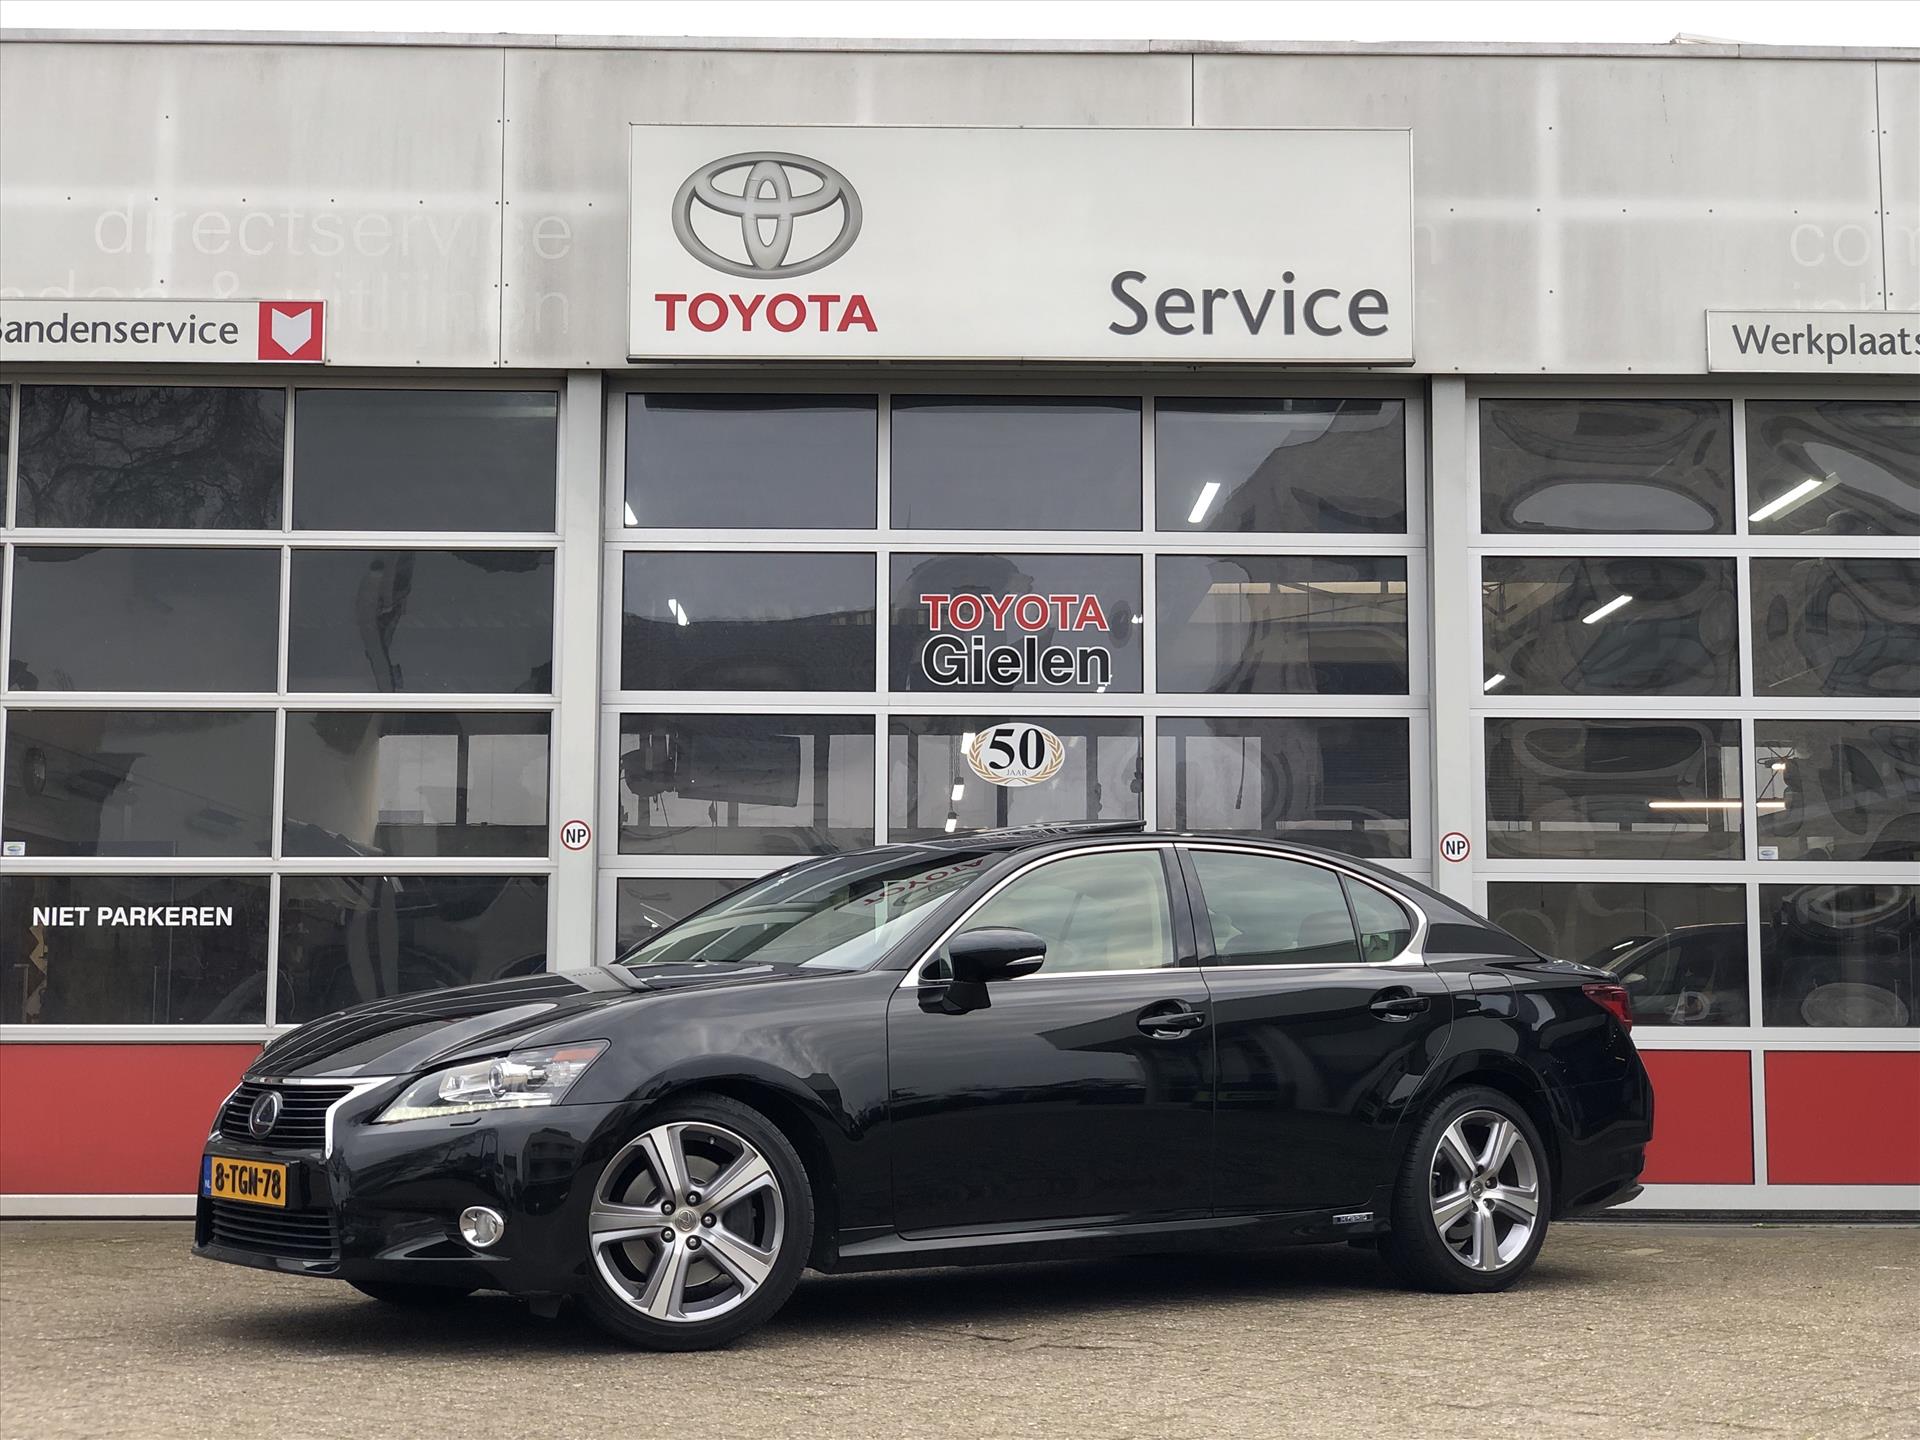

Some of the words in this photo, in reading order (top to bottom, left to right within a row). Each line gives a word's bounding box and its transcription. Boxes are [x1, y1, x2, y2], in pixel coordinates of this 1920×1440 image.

[655, 293, 878, 333] TOYOTA
[1109, 271, 1389, 336] Service
[0, 313, 239, 344] andenservice
[920, 594, 1110, 631] TOYOTA
[922, 634, 1112, 685] Gielen
[988, 728, 1045, 770] 50
[566, 829, 586, 843] NP
[1446, 840, 1465, 855] NP
[32, 907, 90, 926] NIET
[97, 907, 233, 926] PARKEREN
[215, 1162, 281, 1199] 8-TGN-78
